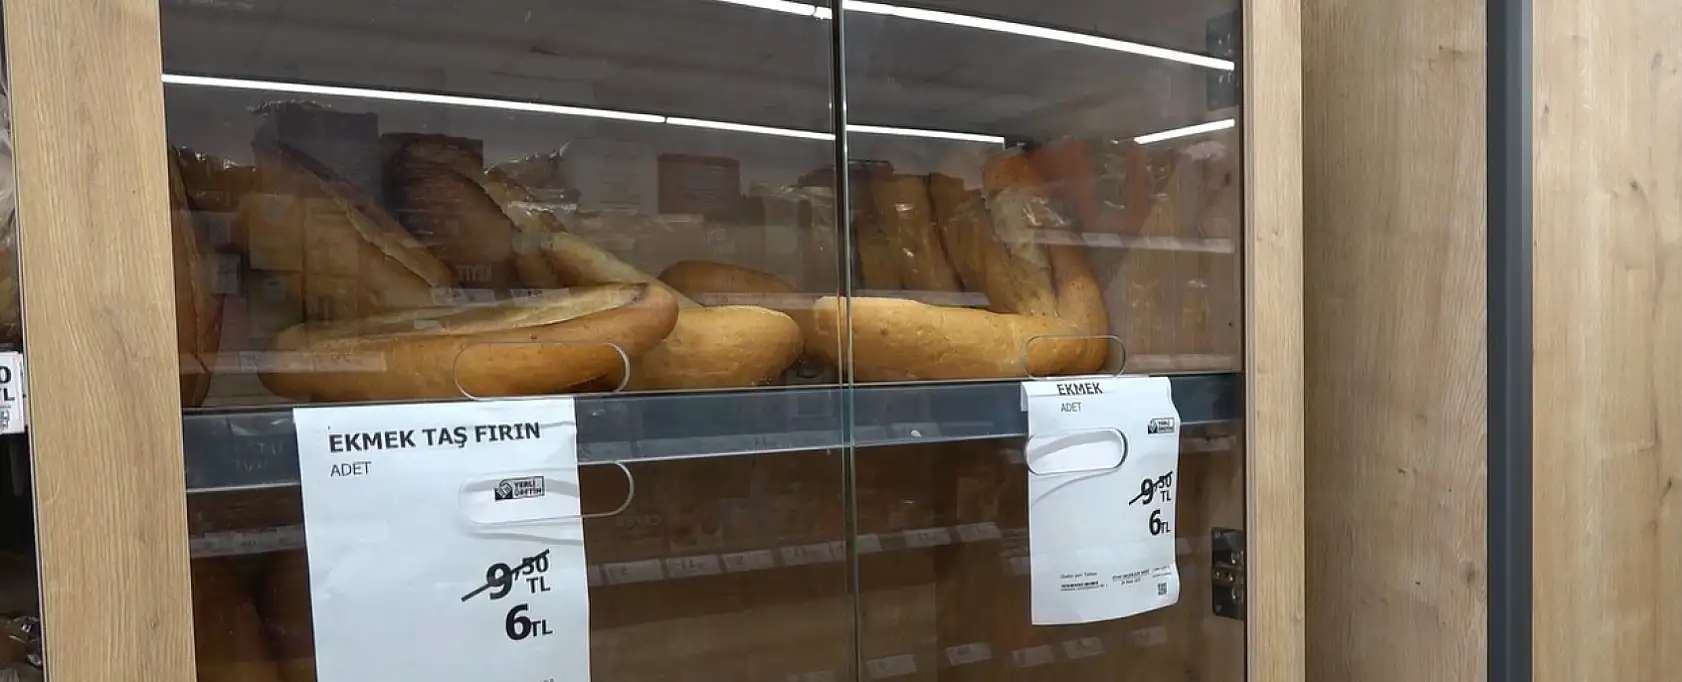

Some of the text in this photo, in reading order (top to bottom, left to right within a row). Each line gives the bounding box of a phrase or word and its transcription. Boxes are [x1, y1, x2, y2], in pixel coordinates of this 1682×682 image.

[0, 388, 15, 401] L
[1056, 382, 1103, 396] EKMEK
[1060, 401, 1082, 412] ADET
[329, 422, 541, 453] EKMEK TAŞ FIRIN
[330, 461, 372, 477] ADET
[1160, 490, 1171, 502] TL
[526, 576, 551, 594] TL
